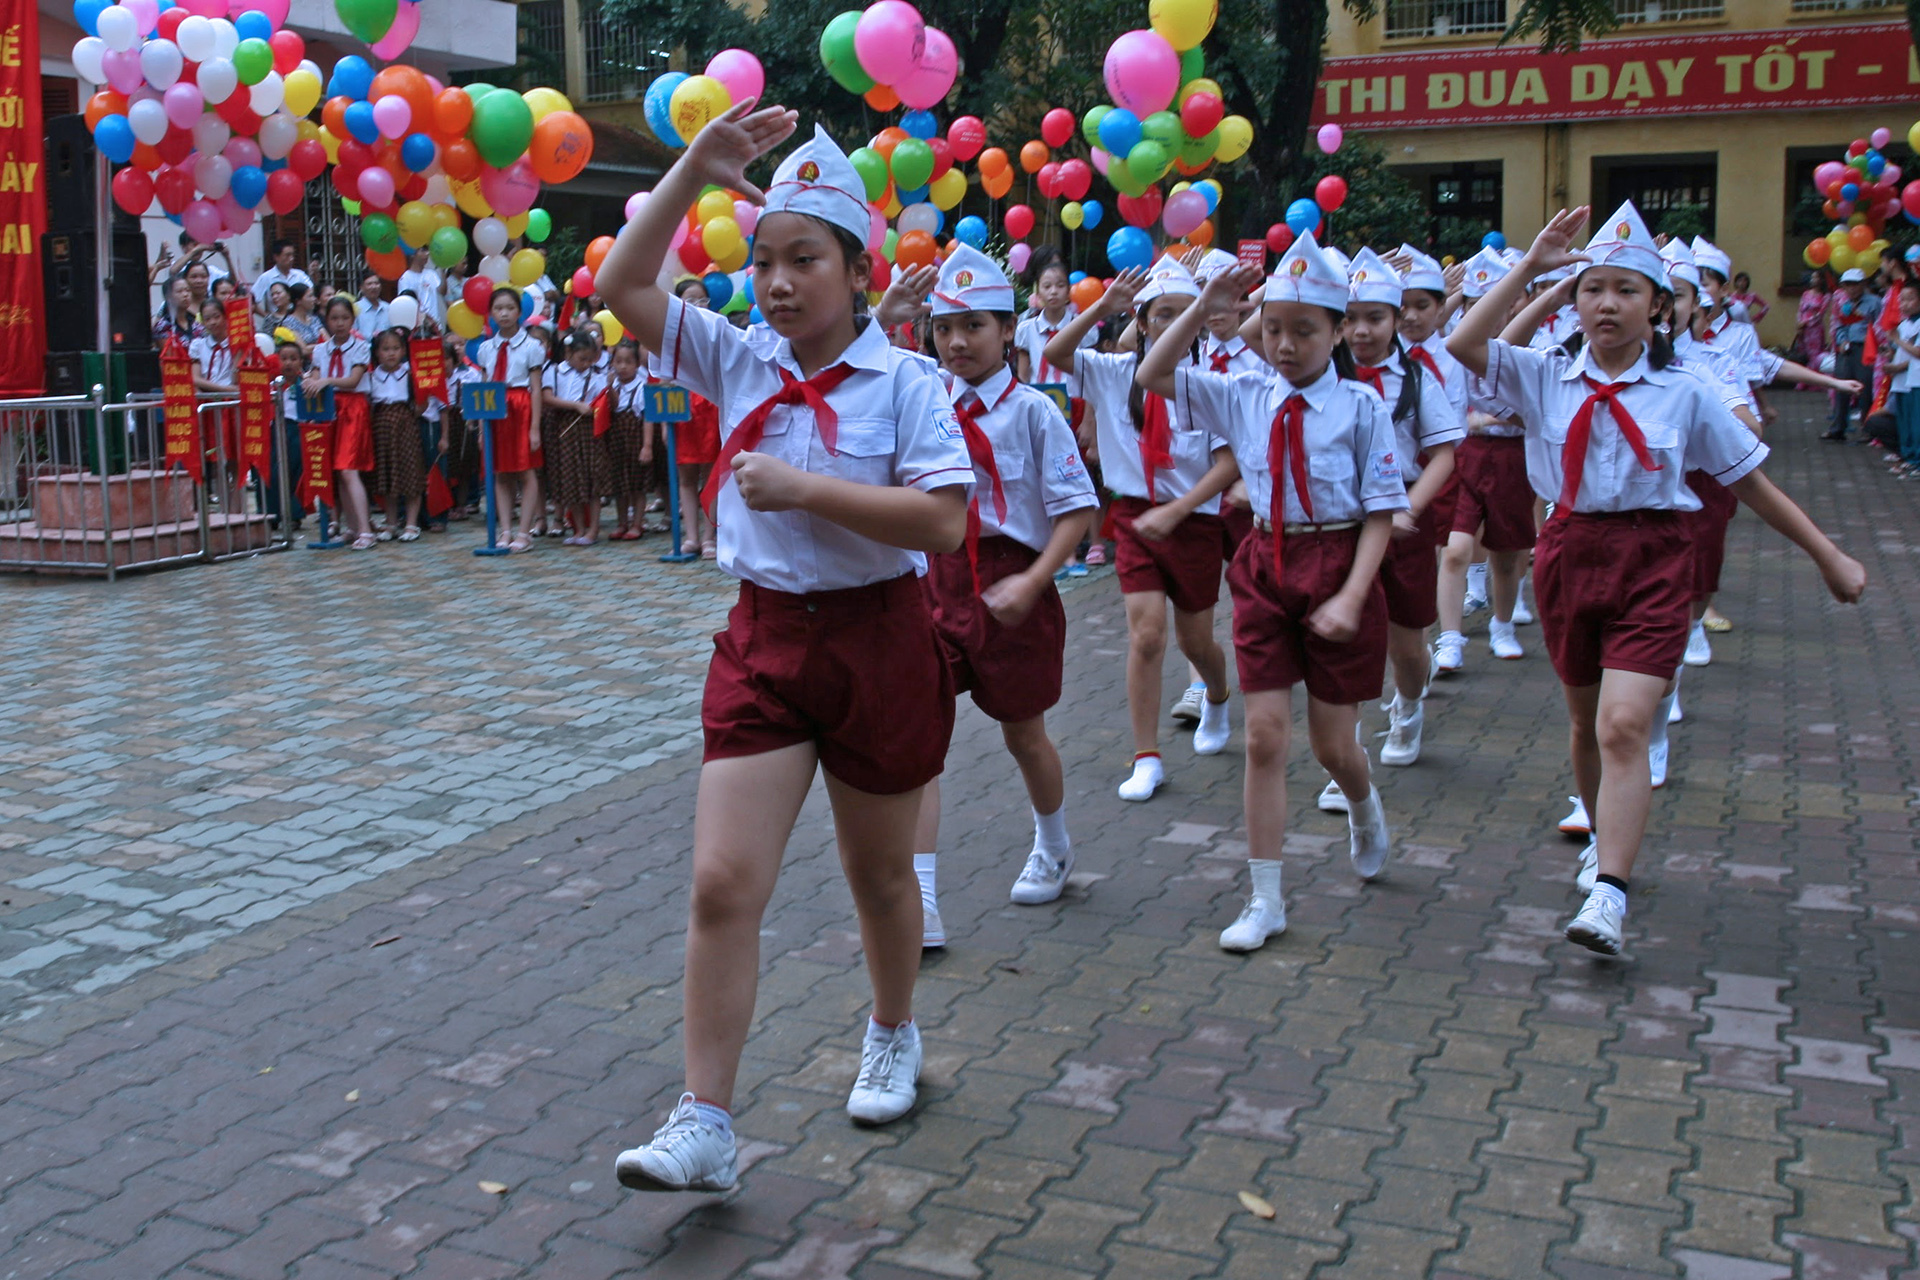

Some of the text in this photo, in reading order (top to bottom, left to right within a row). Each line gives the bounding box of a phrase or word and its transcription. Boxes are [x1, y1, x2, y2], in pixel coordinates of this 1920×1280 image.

[1319, 75, 1406, 115] THI
[1425, 67, 1549, 109] ĐUA
[1571, 57, 1696, 107] DẠY
[1715, 37, 1836, 94] TỐT
[653, 391, 686, 413] 1M
